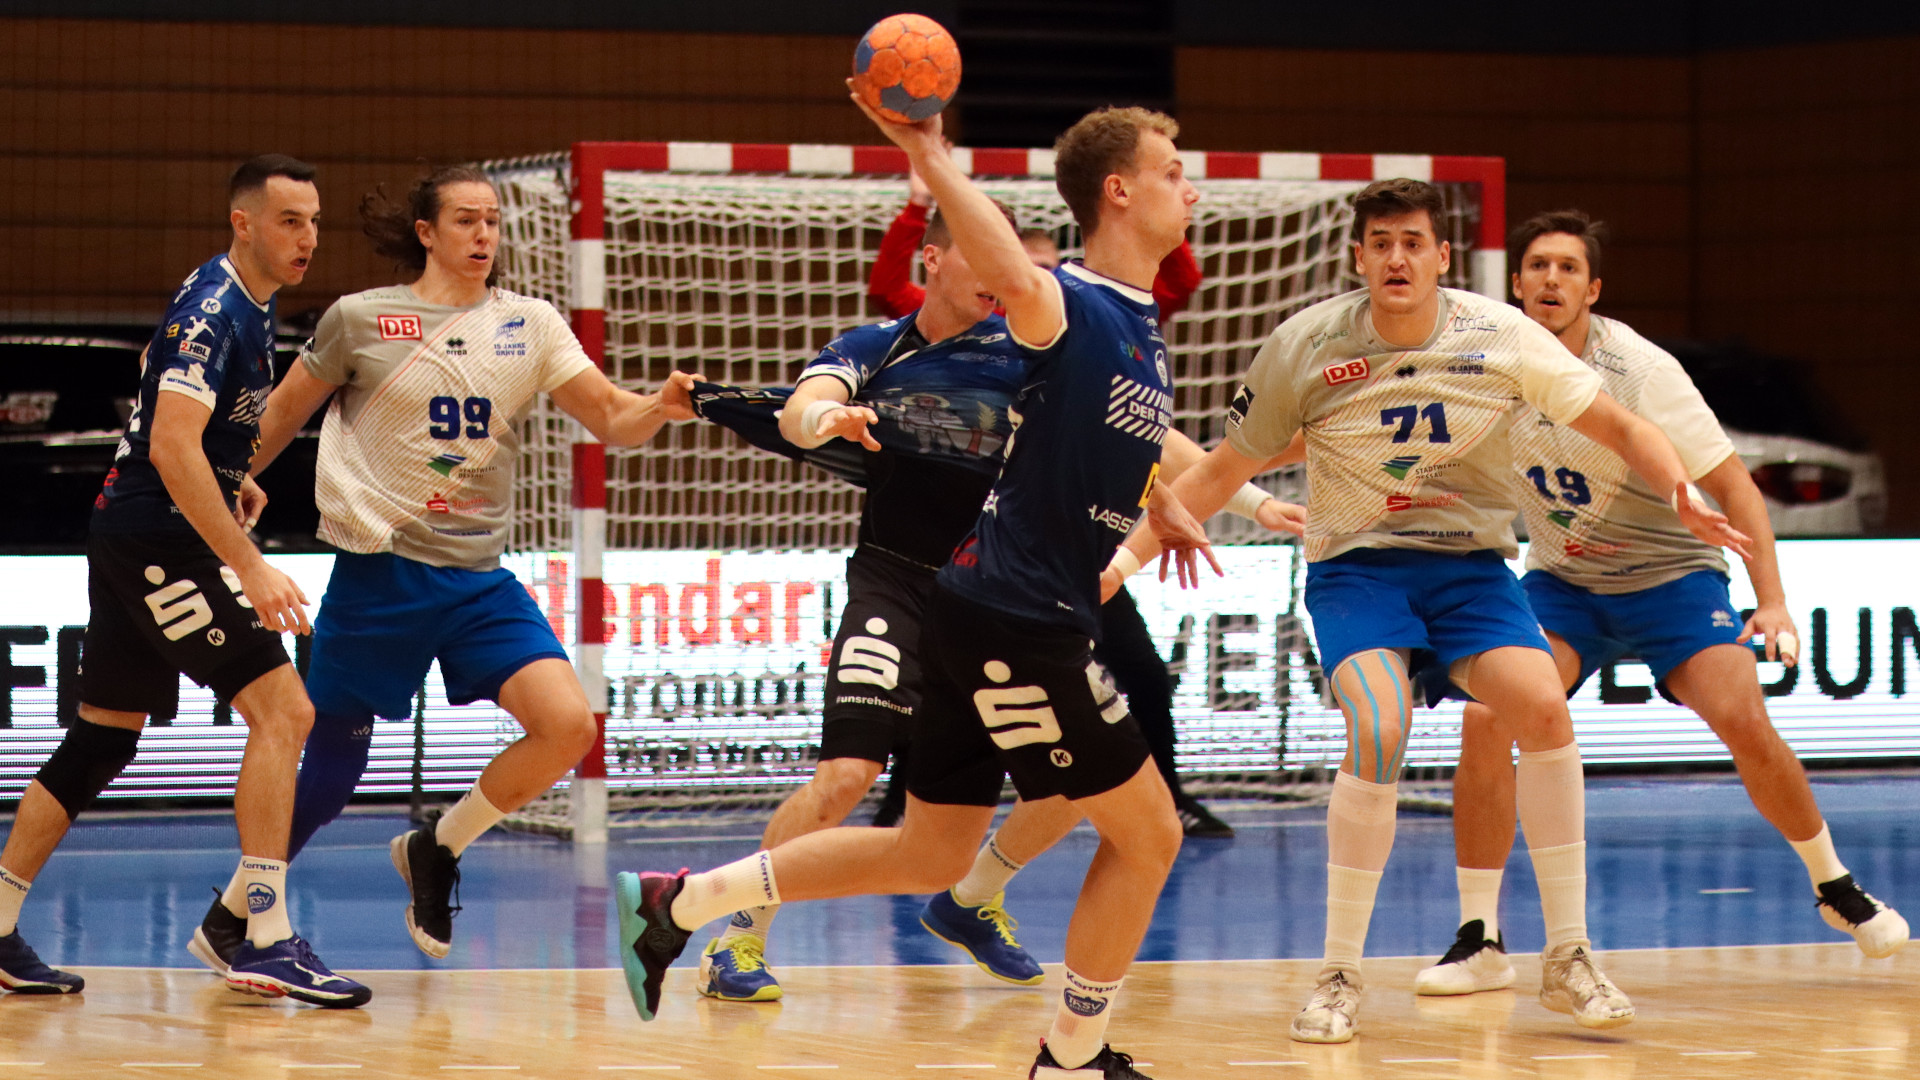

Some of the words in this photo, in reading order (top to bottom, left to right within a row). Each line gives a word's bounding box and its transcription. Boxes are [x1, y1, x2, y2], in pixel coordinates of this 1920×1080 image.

[382, 318, 418, 338] DB
[1327, 360, 1366, 382] DB
[429, 395, 492, 441] 99
[1128, 400, 1156, 422] DER
[1380, 402, 1452, 444] 71
[1526, 465, 1592, 506] 19
[836, 695, 914, 716] #unsreheimat
